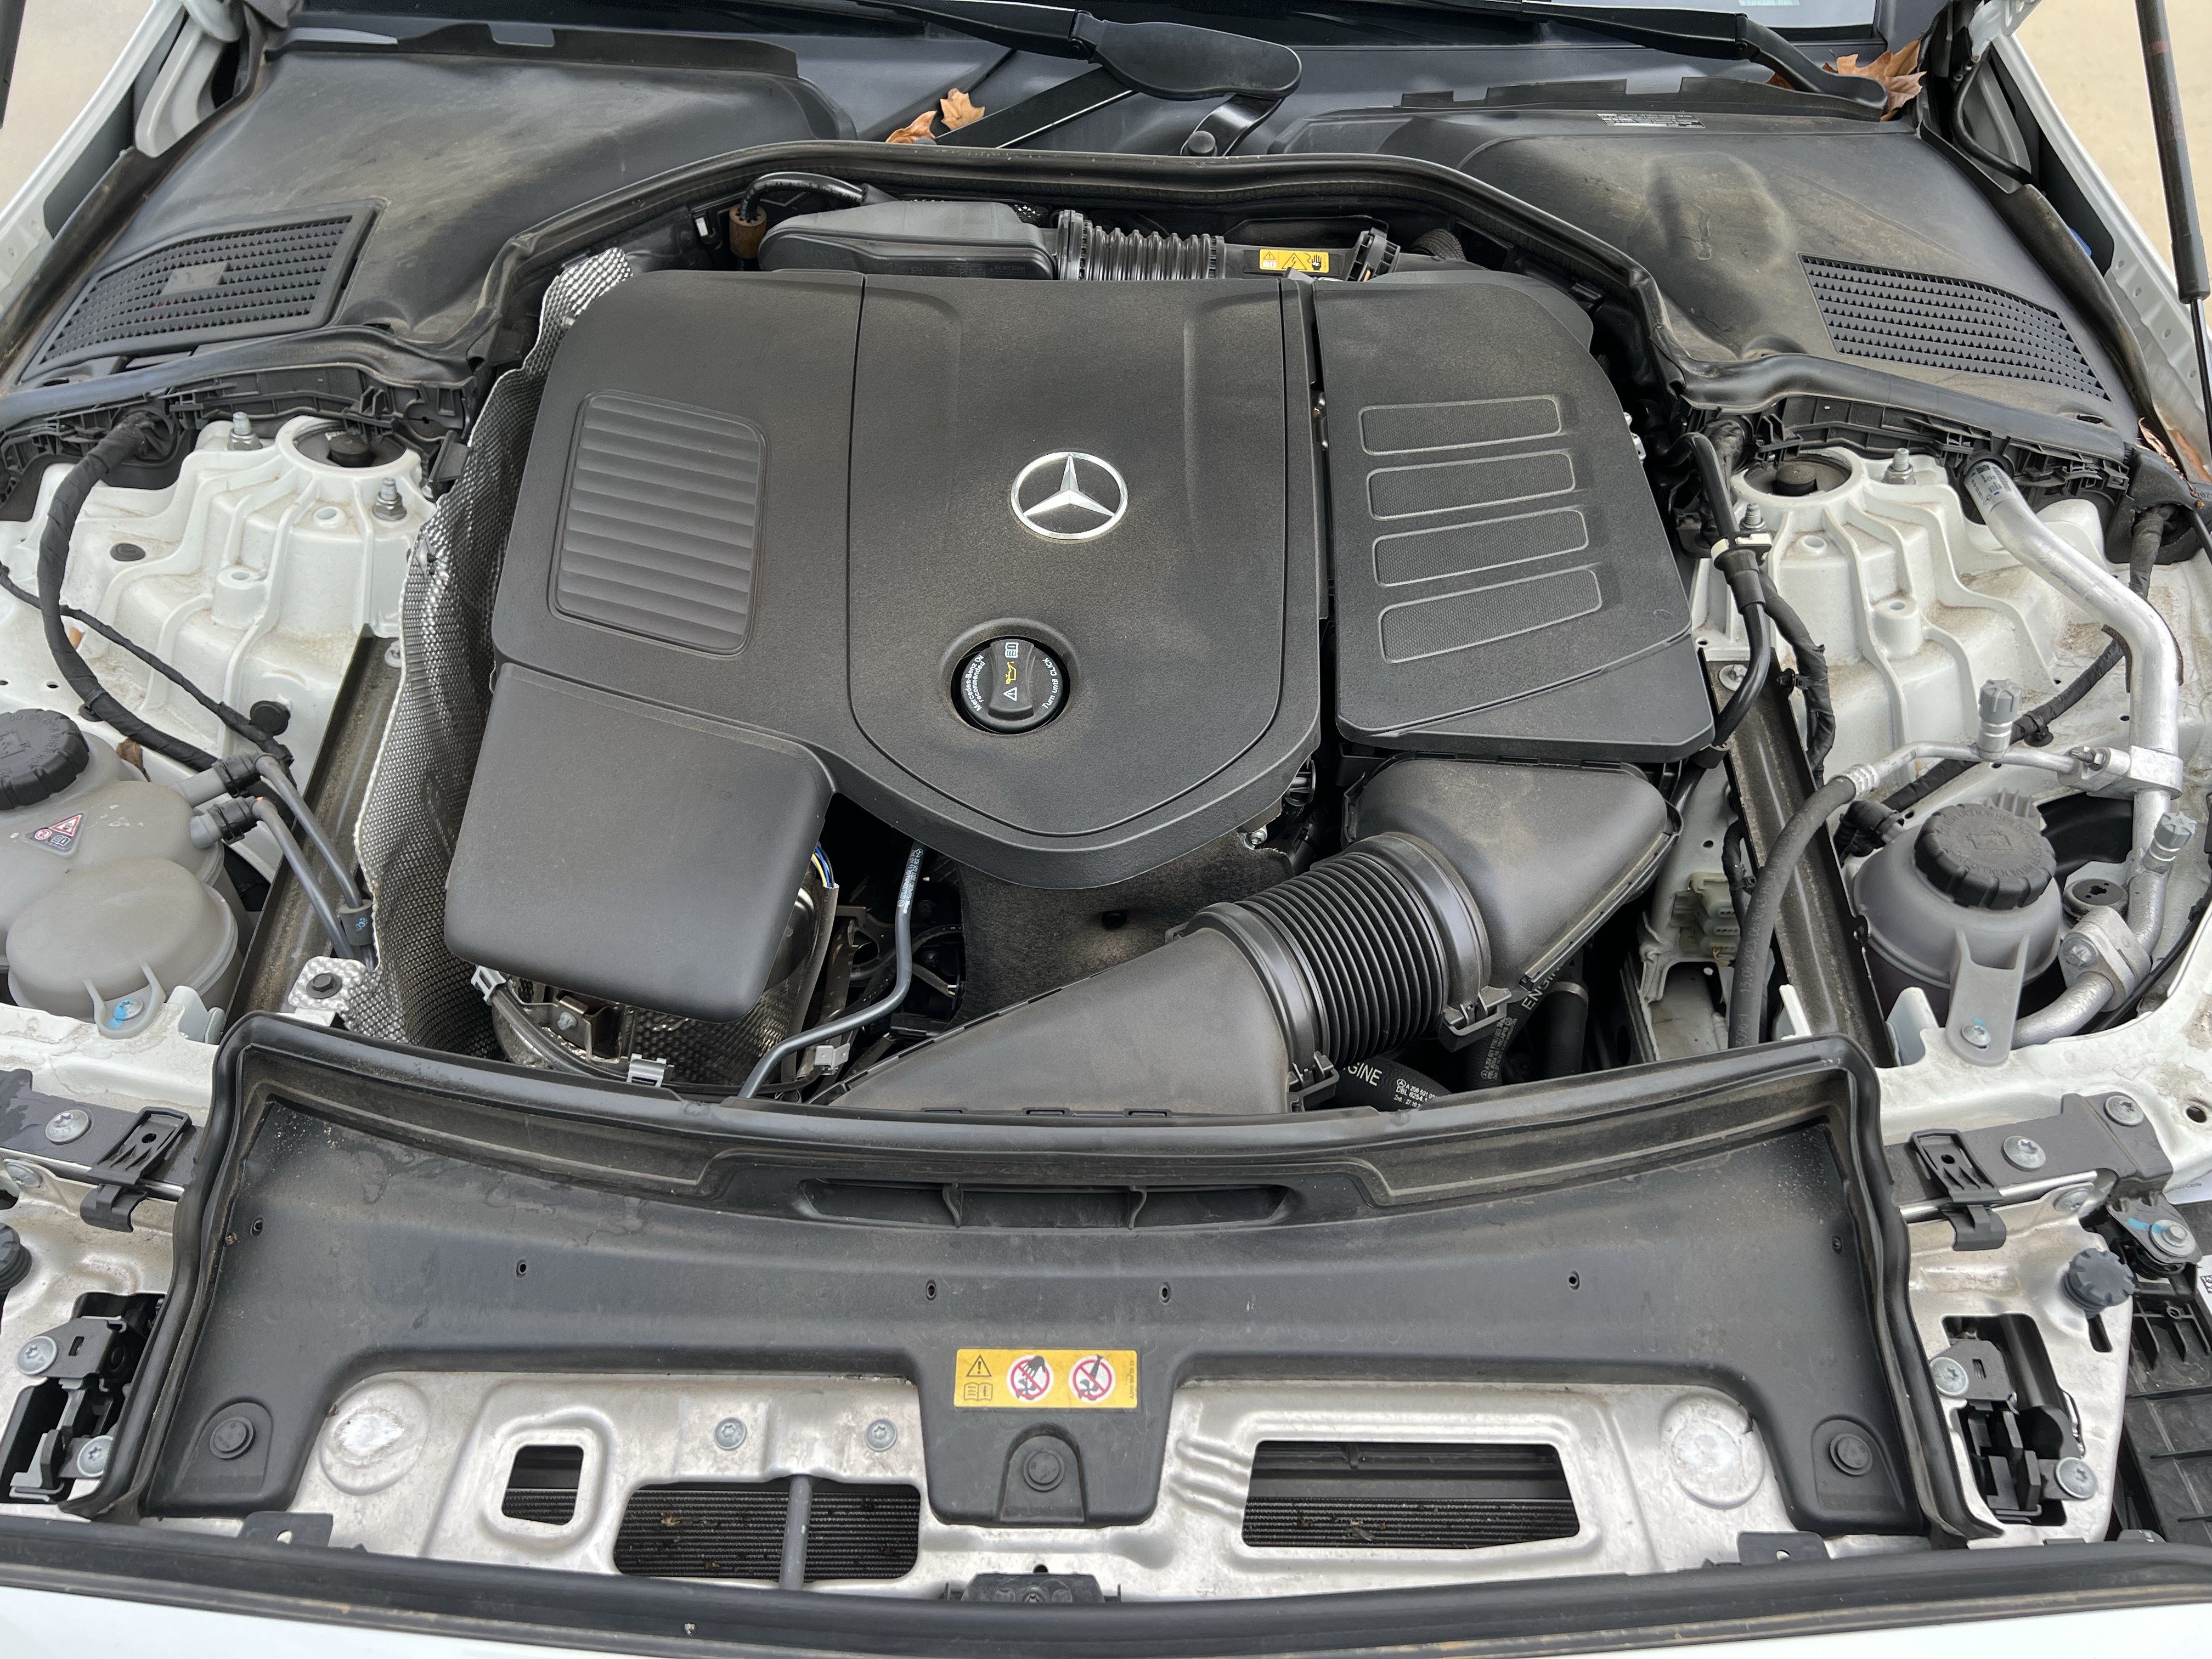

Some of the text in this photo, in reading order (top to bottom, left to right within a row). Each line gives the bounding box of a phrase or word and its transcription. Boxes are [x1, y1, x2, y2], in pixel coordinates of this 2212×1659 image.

[1042, 657, 1057, 676] CLICK
[965, 654, 984, 712] Mercedes-Benz Oil
[972, 661, 985, 702] recommended
[1042, 695, 1056, 709] Turn
[1396, 1086, 1408, 1097] DBL
